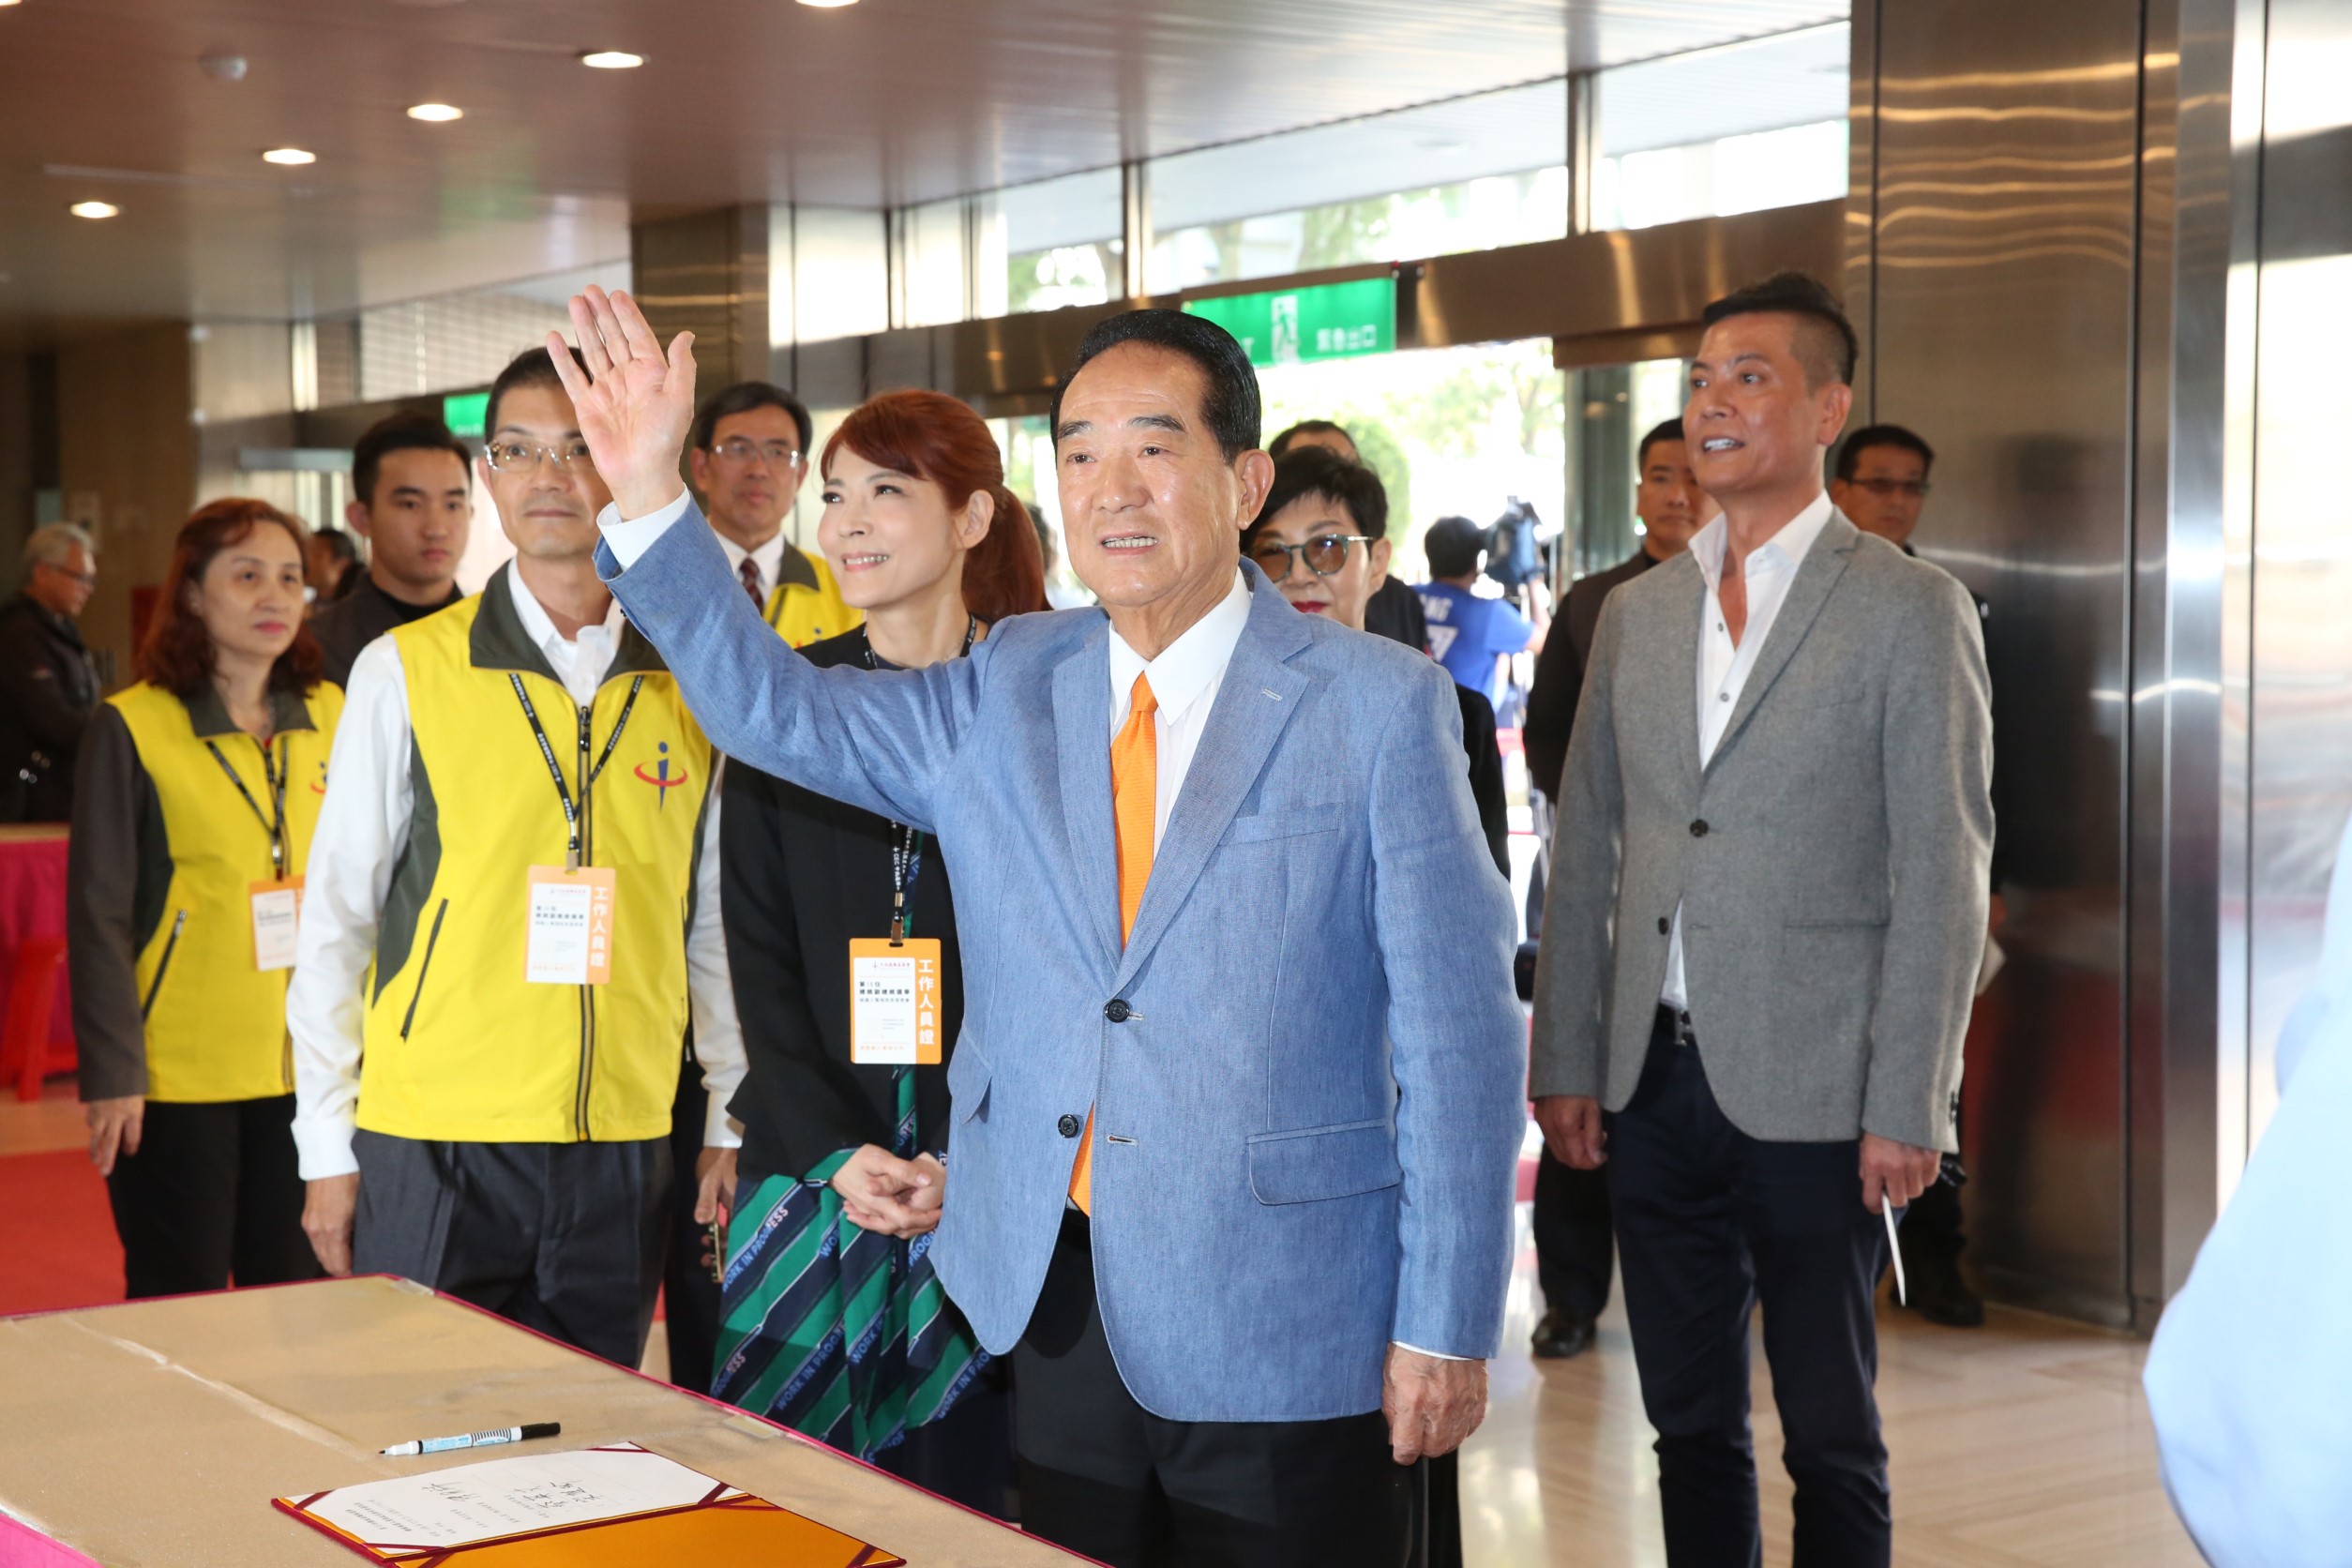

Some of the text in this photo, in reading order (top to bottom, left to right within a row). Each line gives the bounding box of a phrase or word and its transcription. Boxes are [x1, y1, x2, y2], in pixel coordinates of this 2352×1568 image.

[918, 959, 934, 1045] 工作人員證
[741, 1251, 755, 1267] IN
[851, 1333, 878, 1364] WORK
[776, 1380, 805, 1410] WORK
[803, 1364, 816, 1380] IN
[958, 1376, 972, 1388] IN
